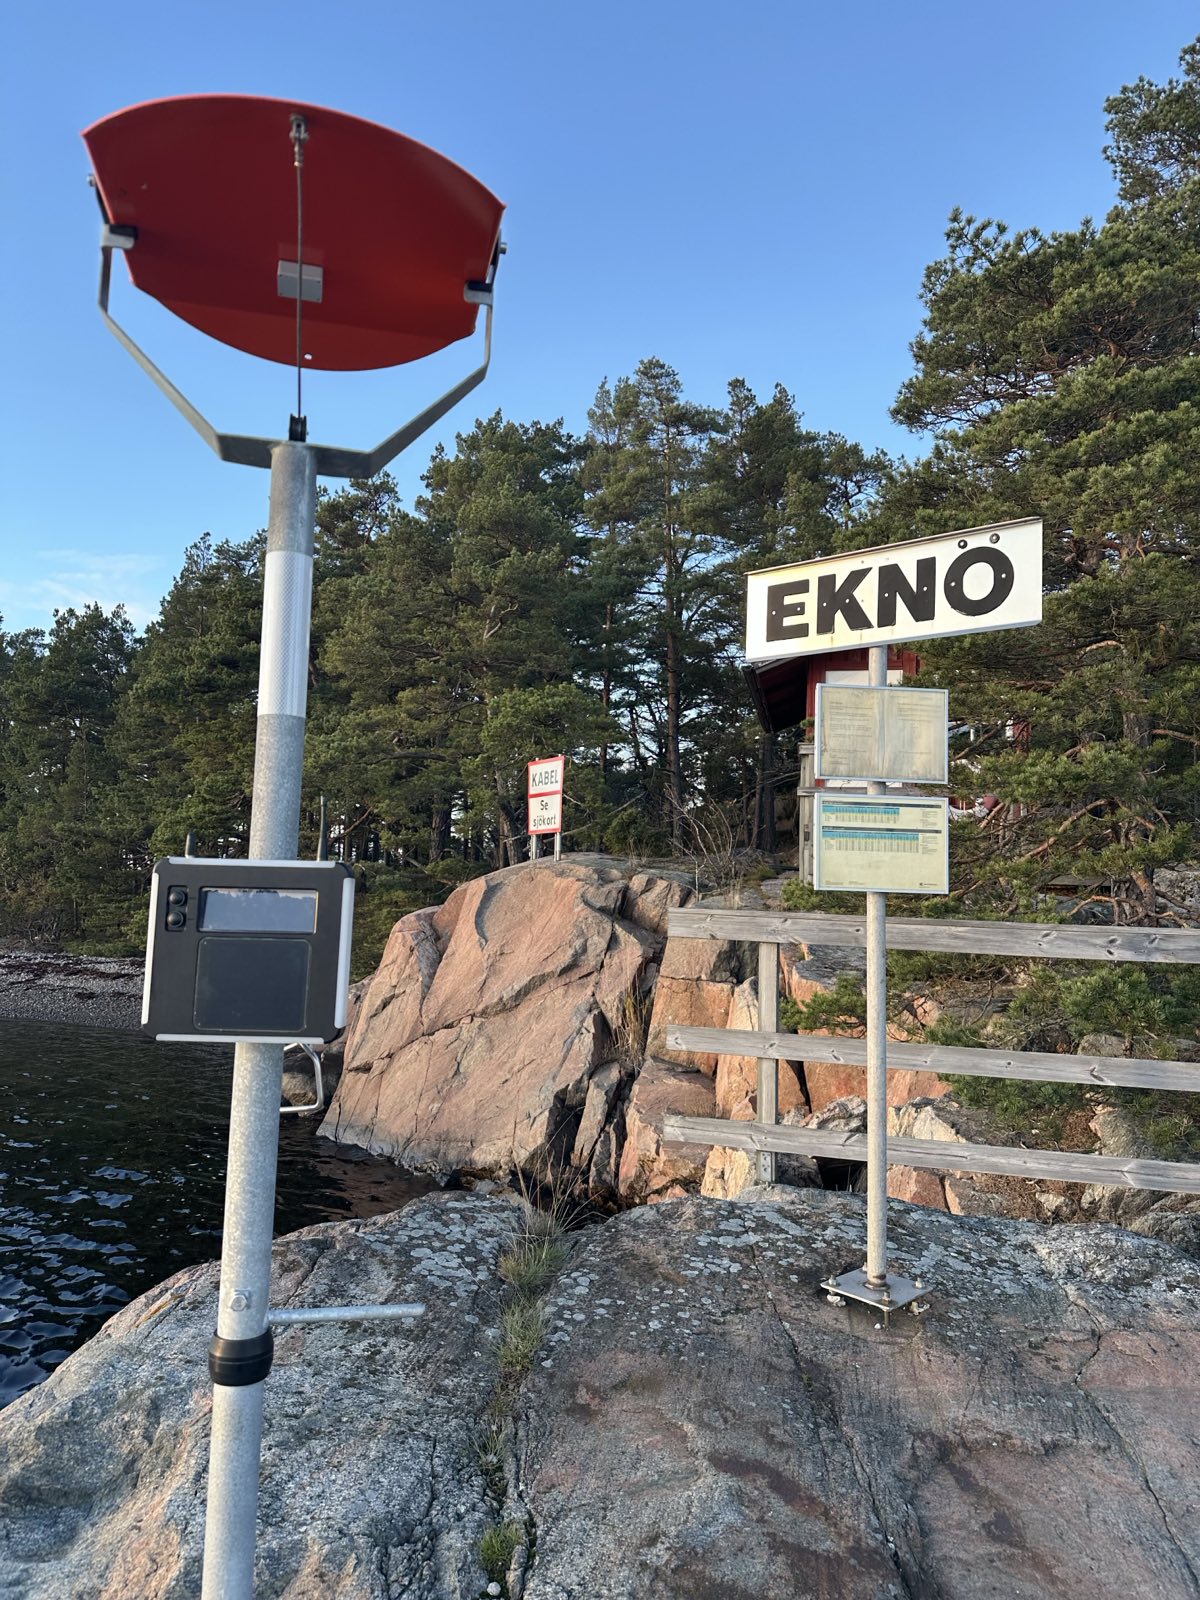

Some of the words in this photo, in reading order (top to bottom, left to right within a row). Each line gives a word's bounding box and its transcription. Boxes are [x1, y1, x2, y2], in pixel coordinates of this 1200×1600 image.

[766, 533, 1015, 642] EKNÖ
[532, 770, 559, 787] KABEL
[540, 800, 549, 811] Se
[533, 815, 557, 829] sjökort
